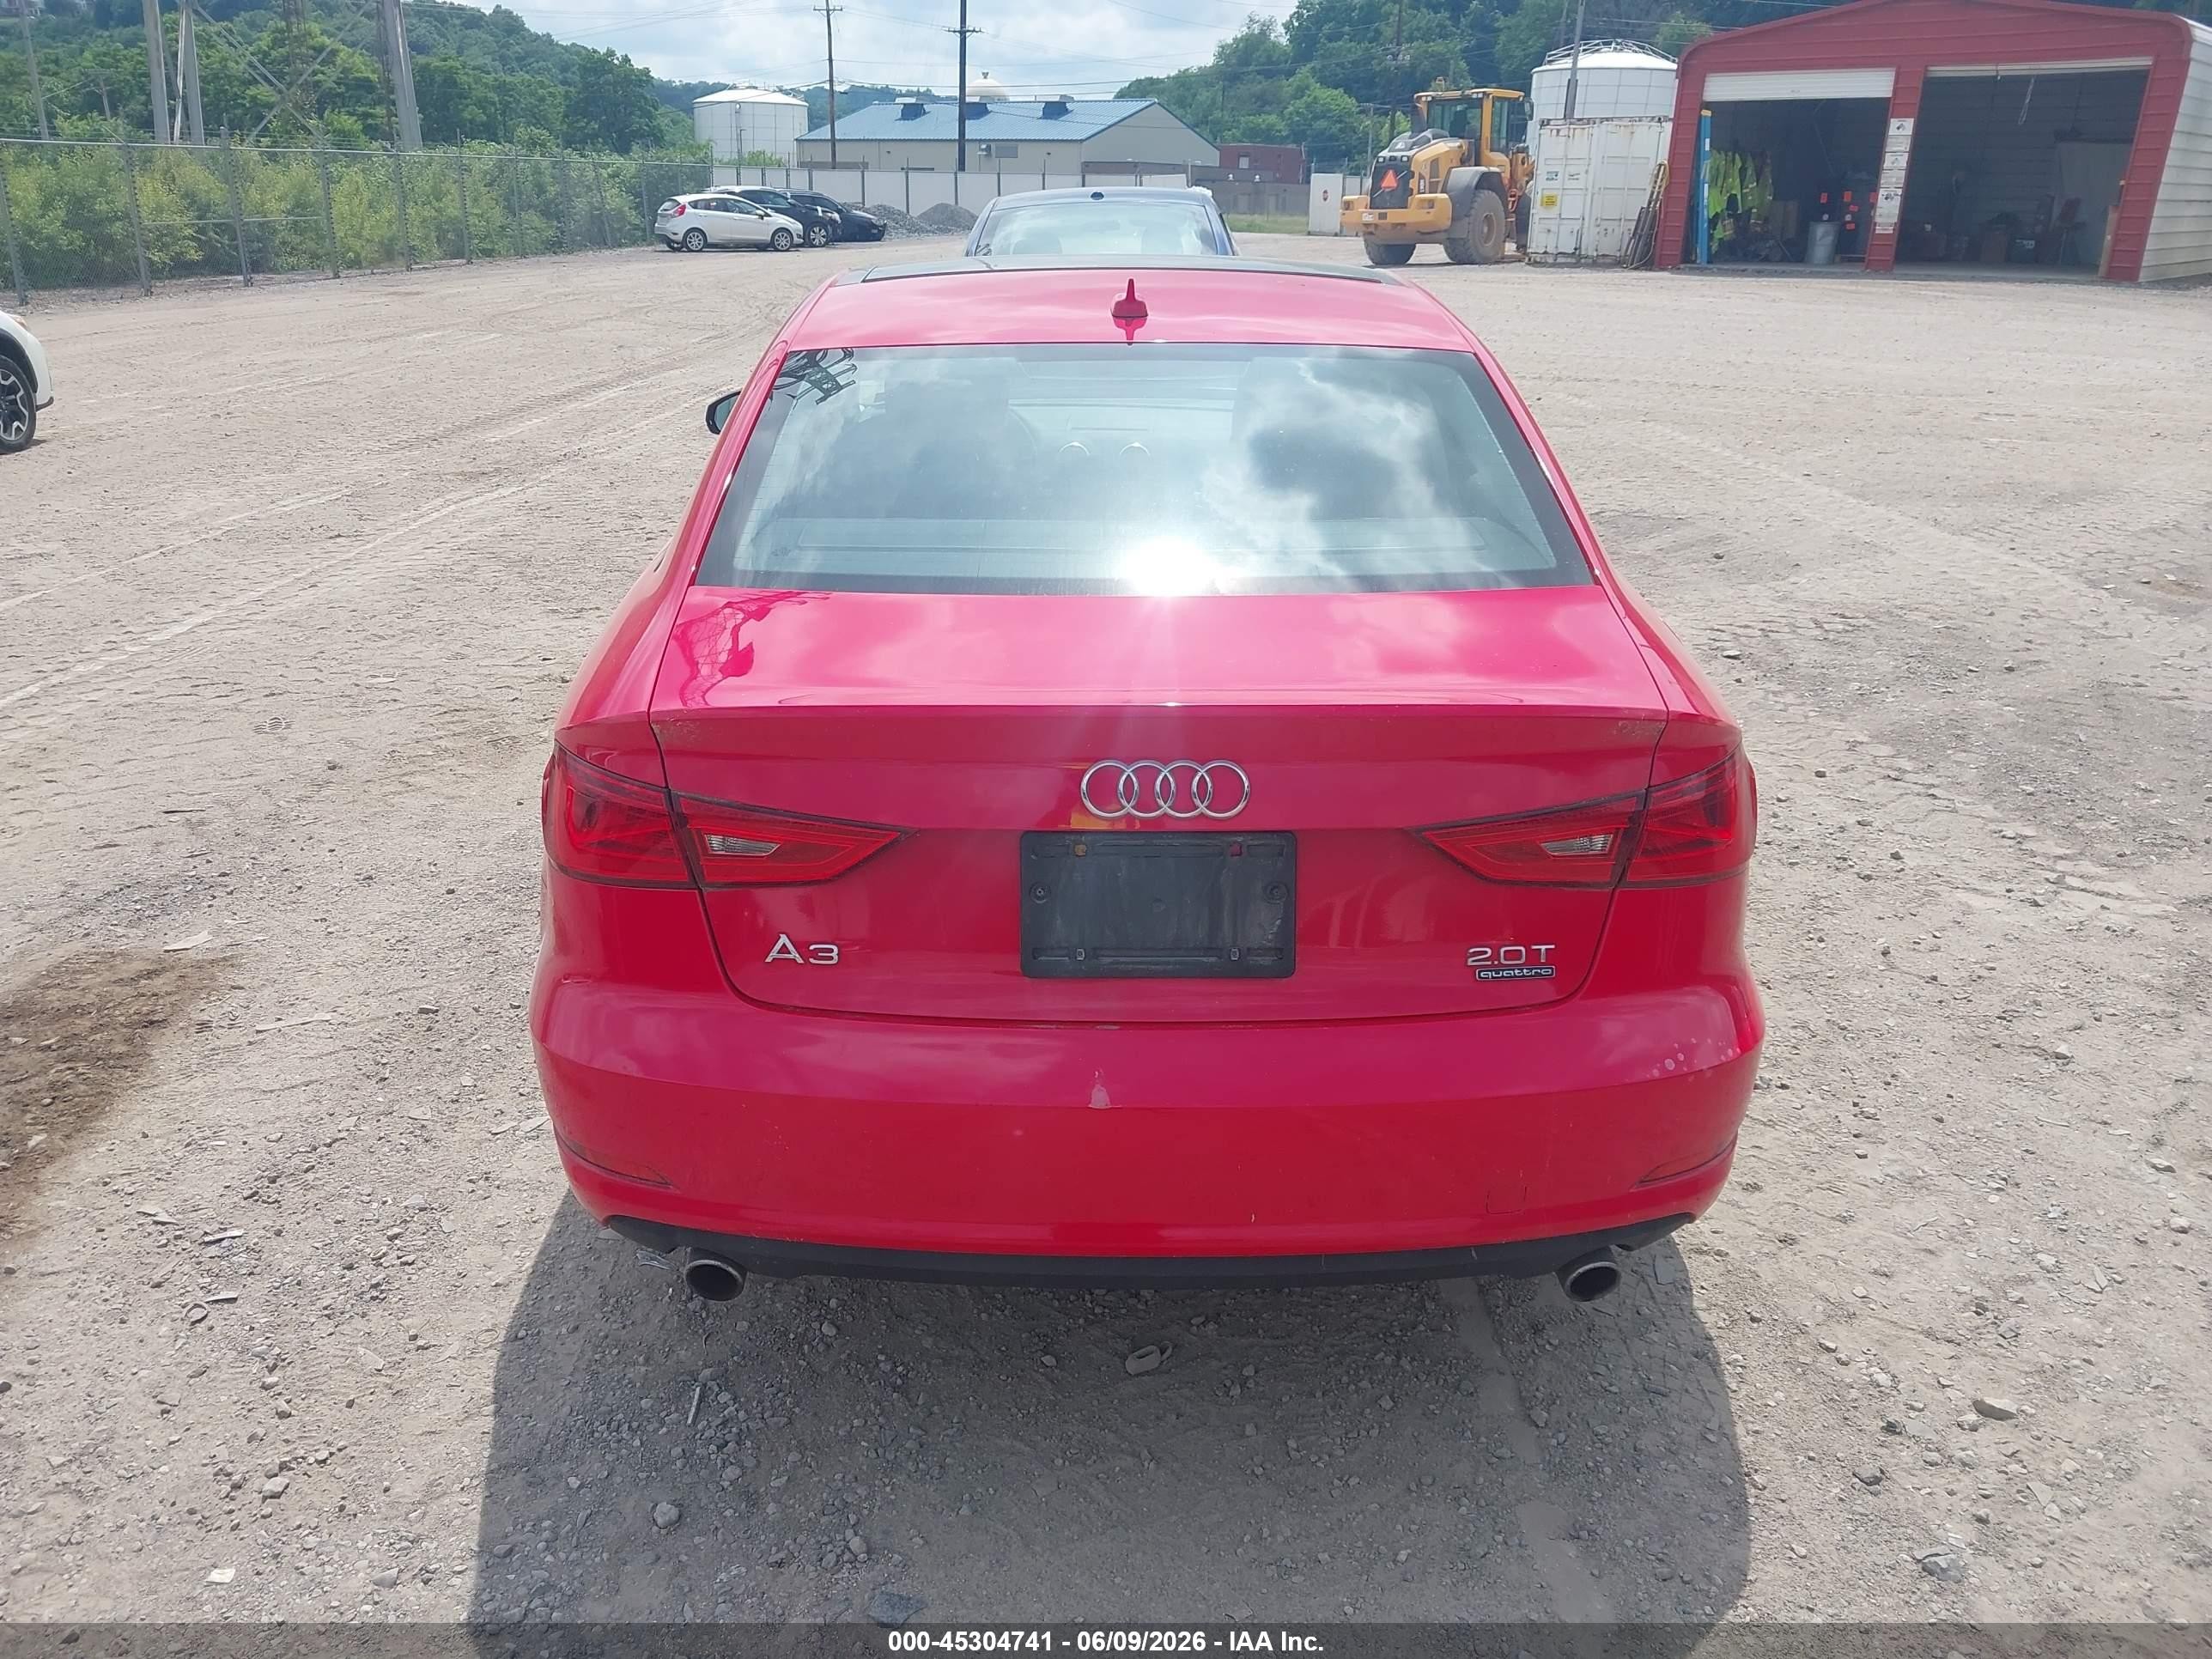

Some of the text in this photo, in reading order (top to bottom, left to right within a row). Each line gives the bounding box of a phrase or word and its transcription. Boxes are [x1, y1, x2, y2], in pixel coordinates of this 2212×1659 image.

[764, 933, 839, 964] A3
[1467, 945, 1555, 966] 2.0T
[1480, 968, 1553, 979] quattro
